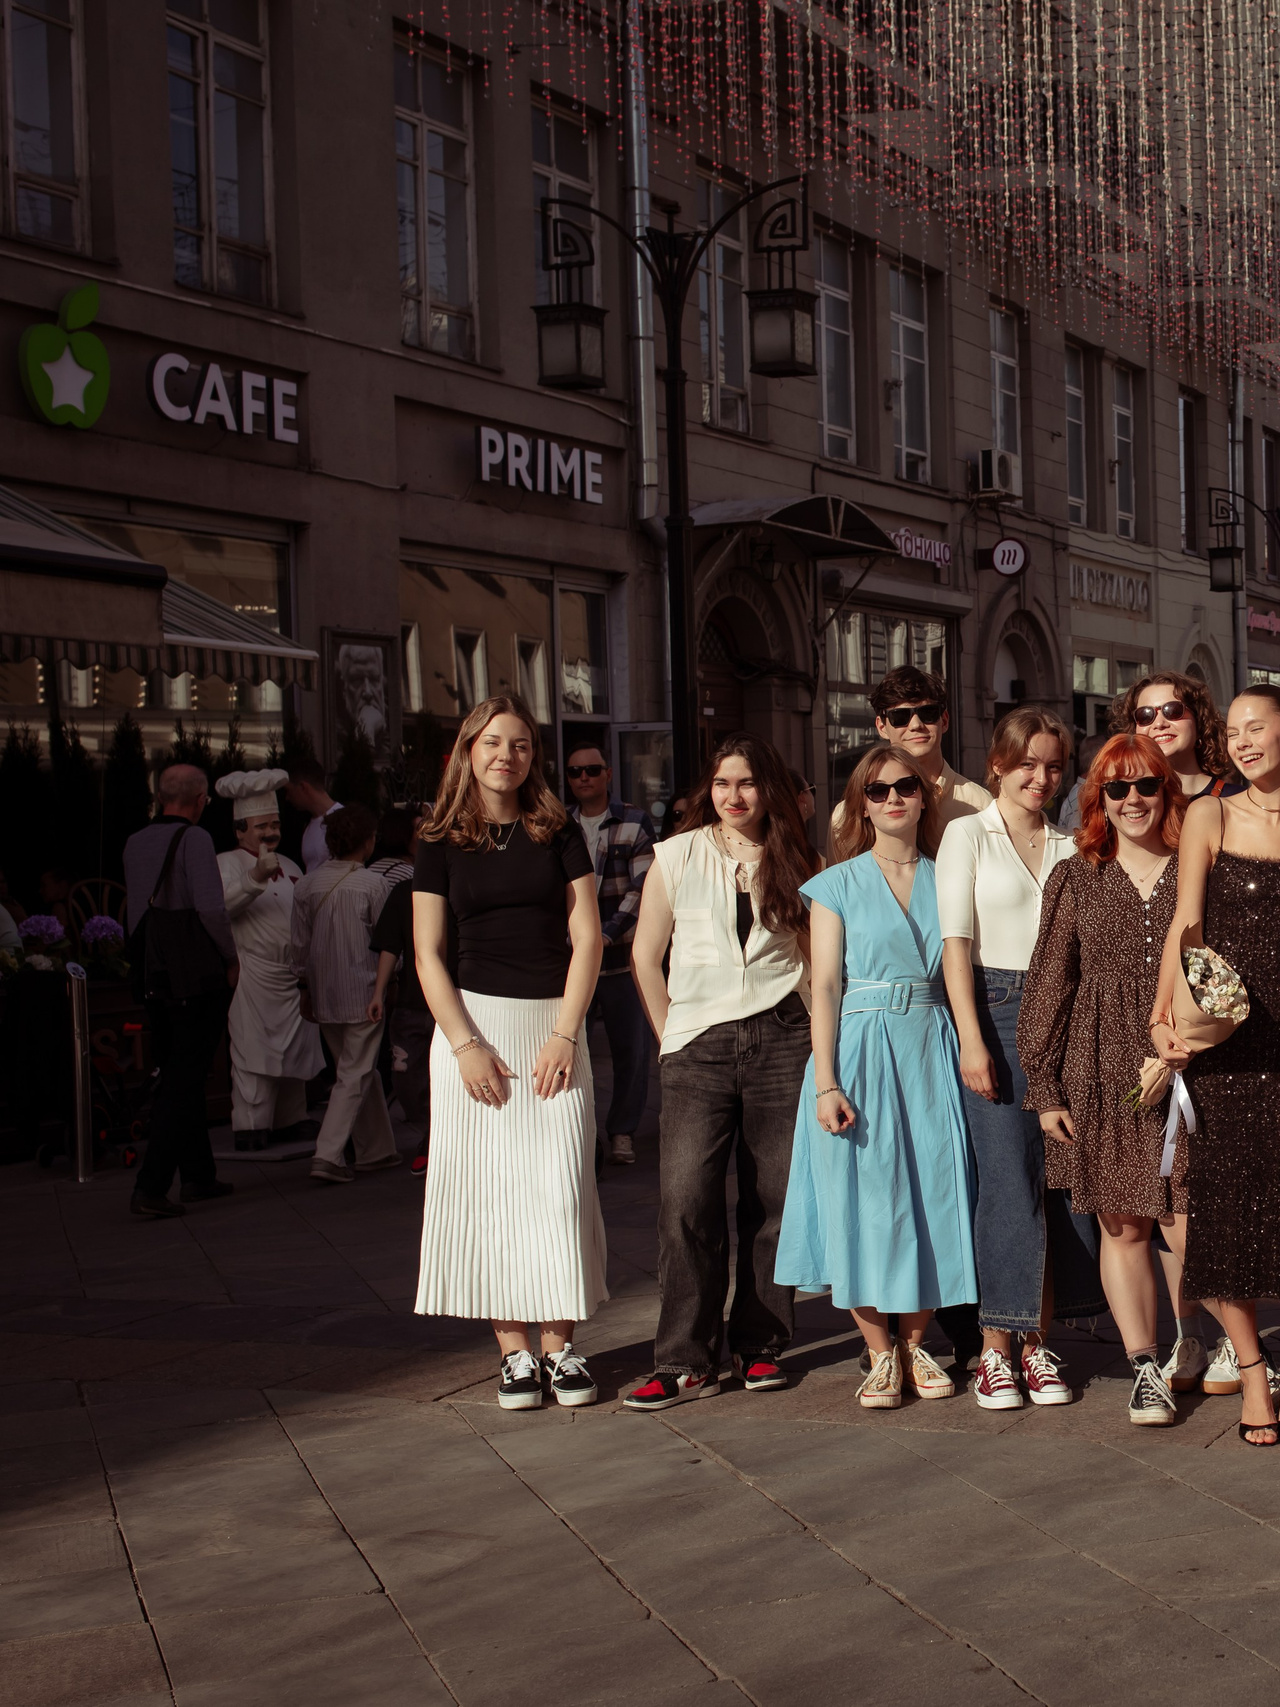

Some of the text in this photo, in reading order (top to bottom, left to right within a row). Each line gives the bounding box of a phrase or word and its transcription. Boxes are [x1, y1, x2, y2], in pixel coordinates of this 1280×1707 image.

[148, 353, 300, 445] CAFE
[476, 426, 604, 505] PRIME
[886, 526, 952, 568] адница
